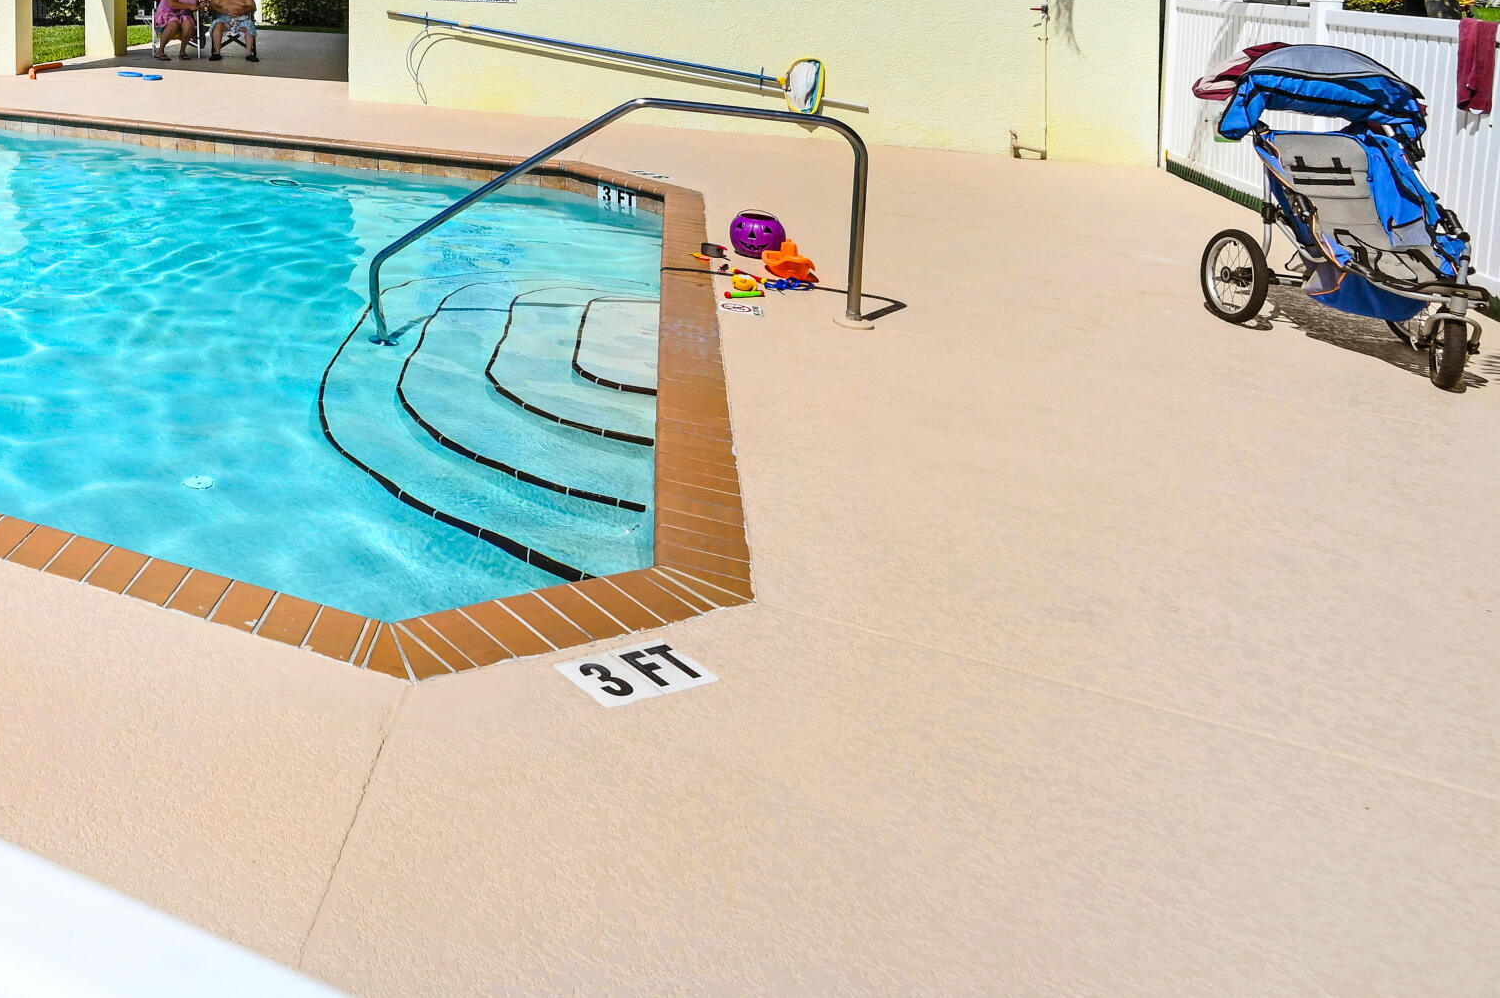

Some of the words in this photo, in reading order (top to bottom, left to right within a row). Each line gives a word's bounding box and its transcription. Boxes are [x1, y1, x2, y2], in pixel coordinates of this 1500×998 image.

[602, 186, 612, 201] 3
[617, 189, 635, 206] FT
[579, 662, 634, 697] 3
[619, 644, 702, 687] FT
